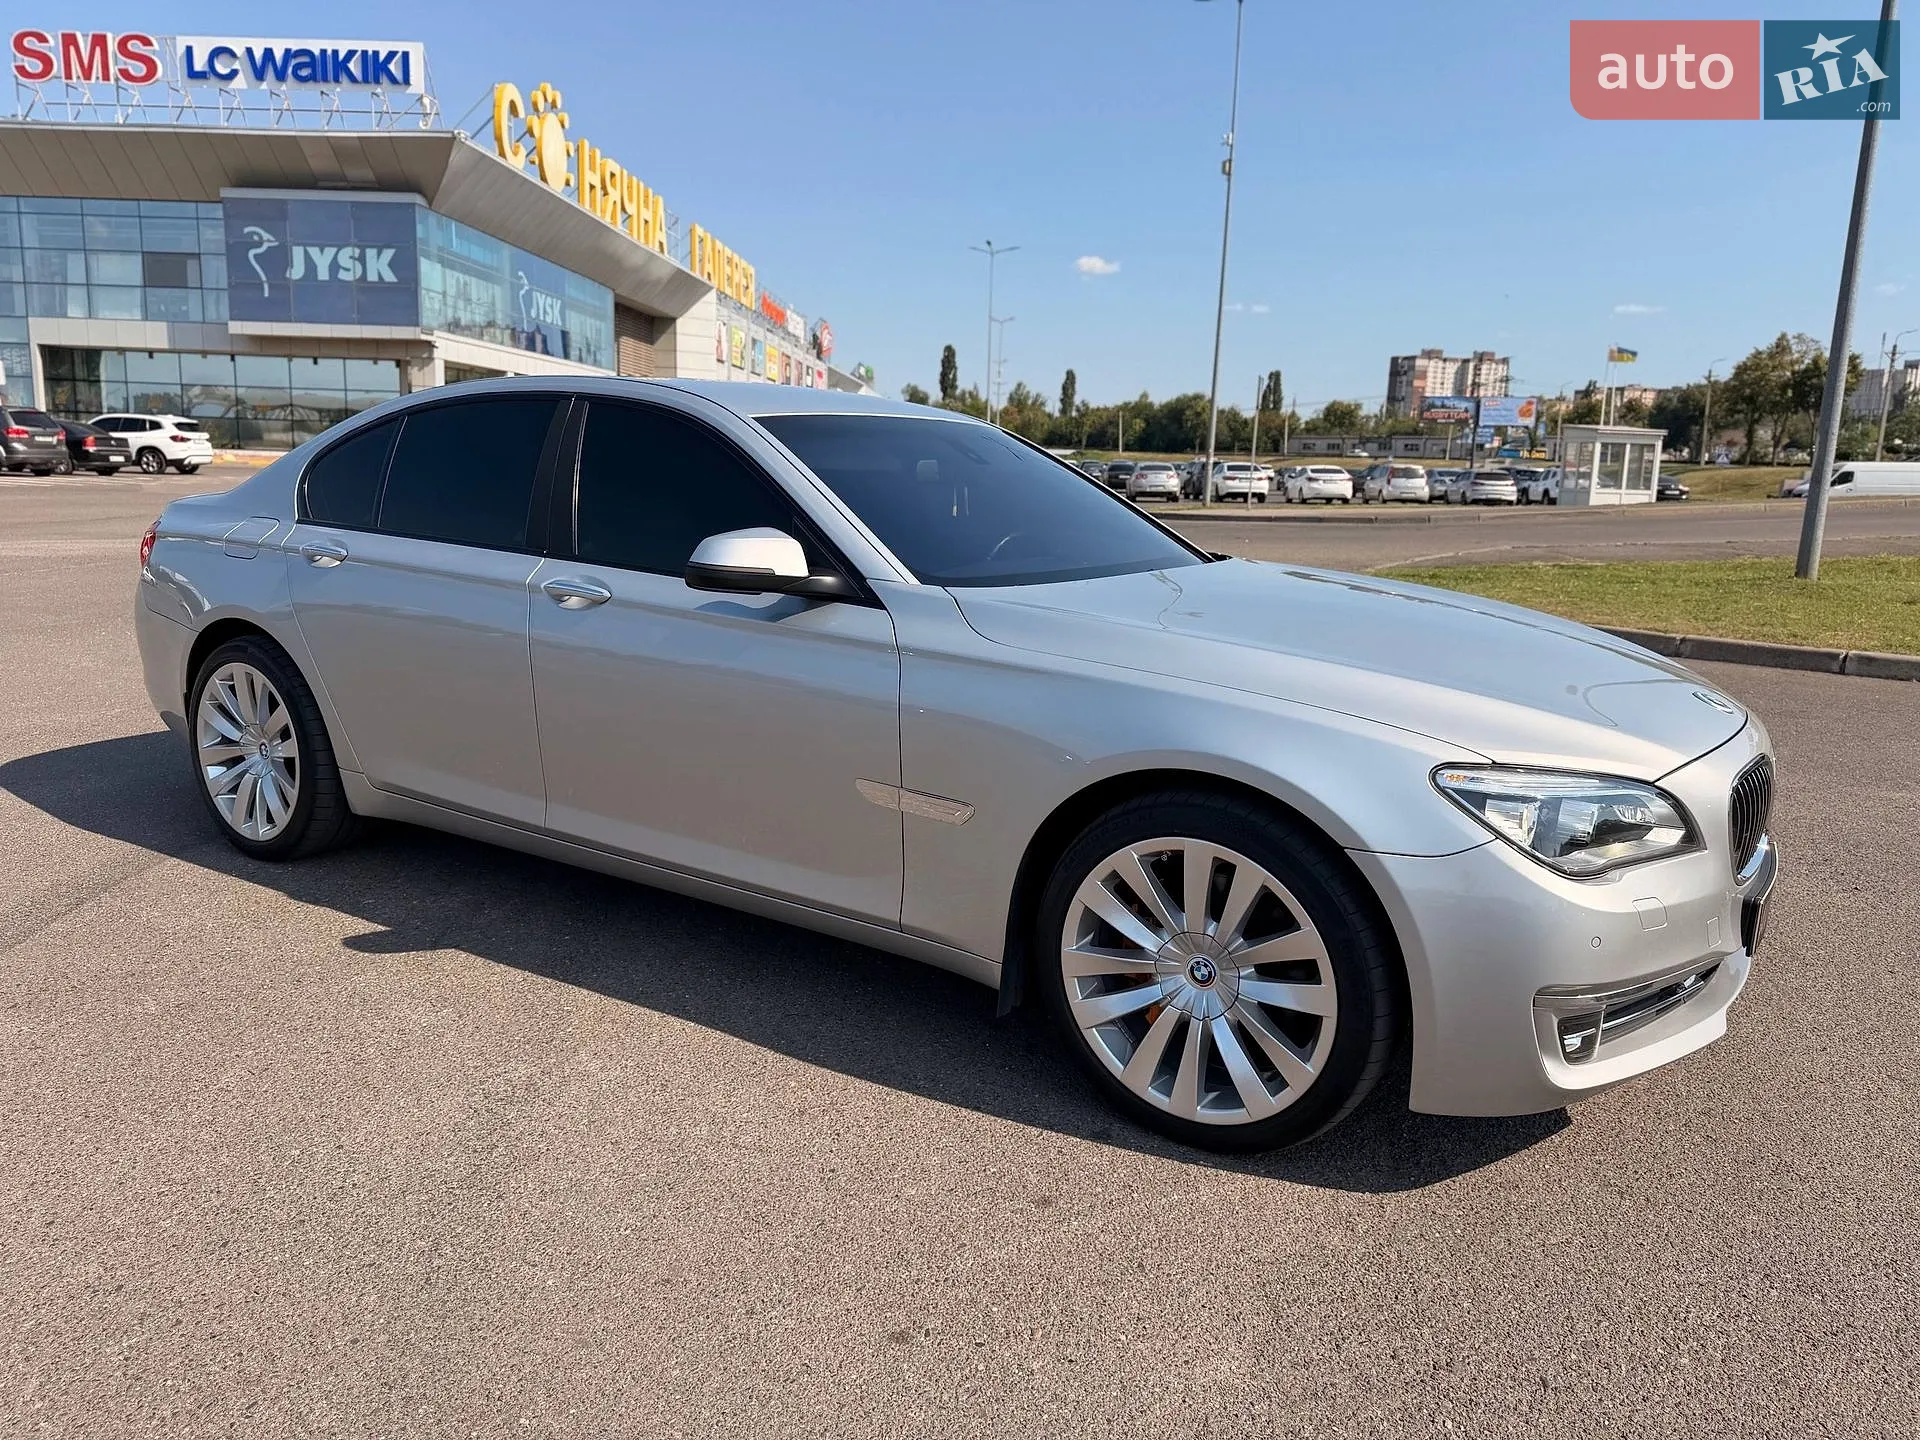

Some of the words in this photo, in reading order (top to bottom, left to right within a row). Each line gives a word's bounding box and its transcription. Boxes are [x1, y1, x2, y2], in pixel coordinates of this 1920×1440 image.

[12, 30, 163, 84] SMS
[185, 44, 241, 80] LC
[286, 246, 399, 283] JYSK
[531, 290, 562, 326] JYSK
